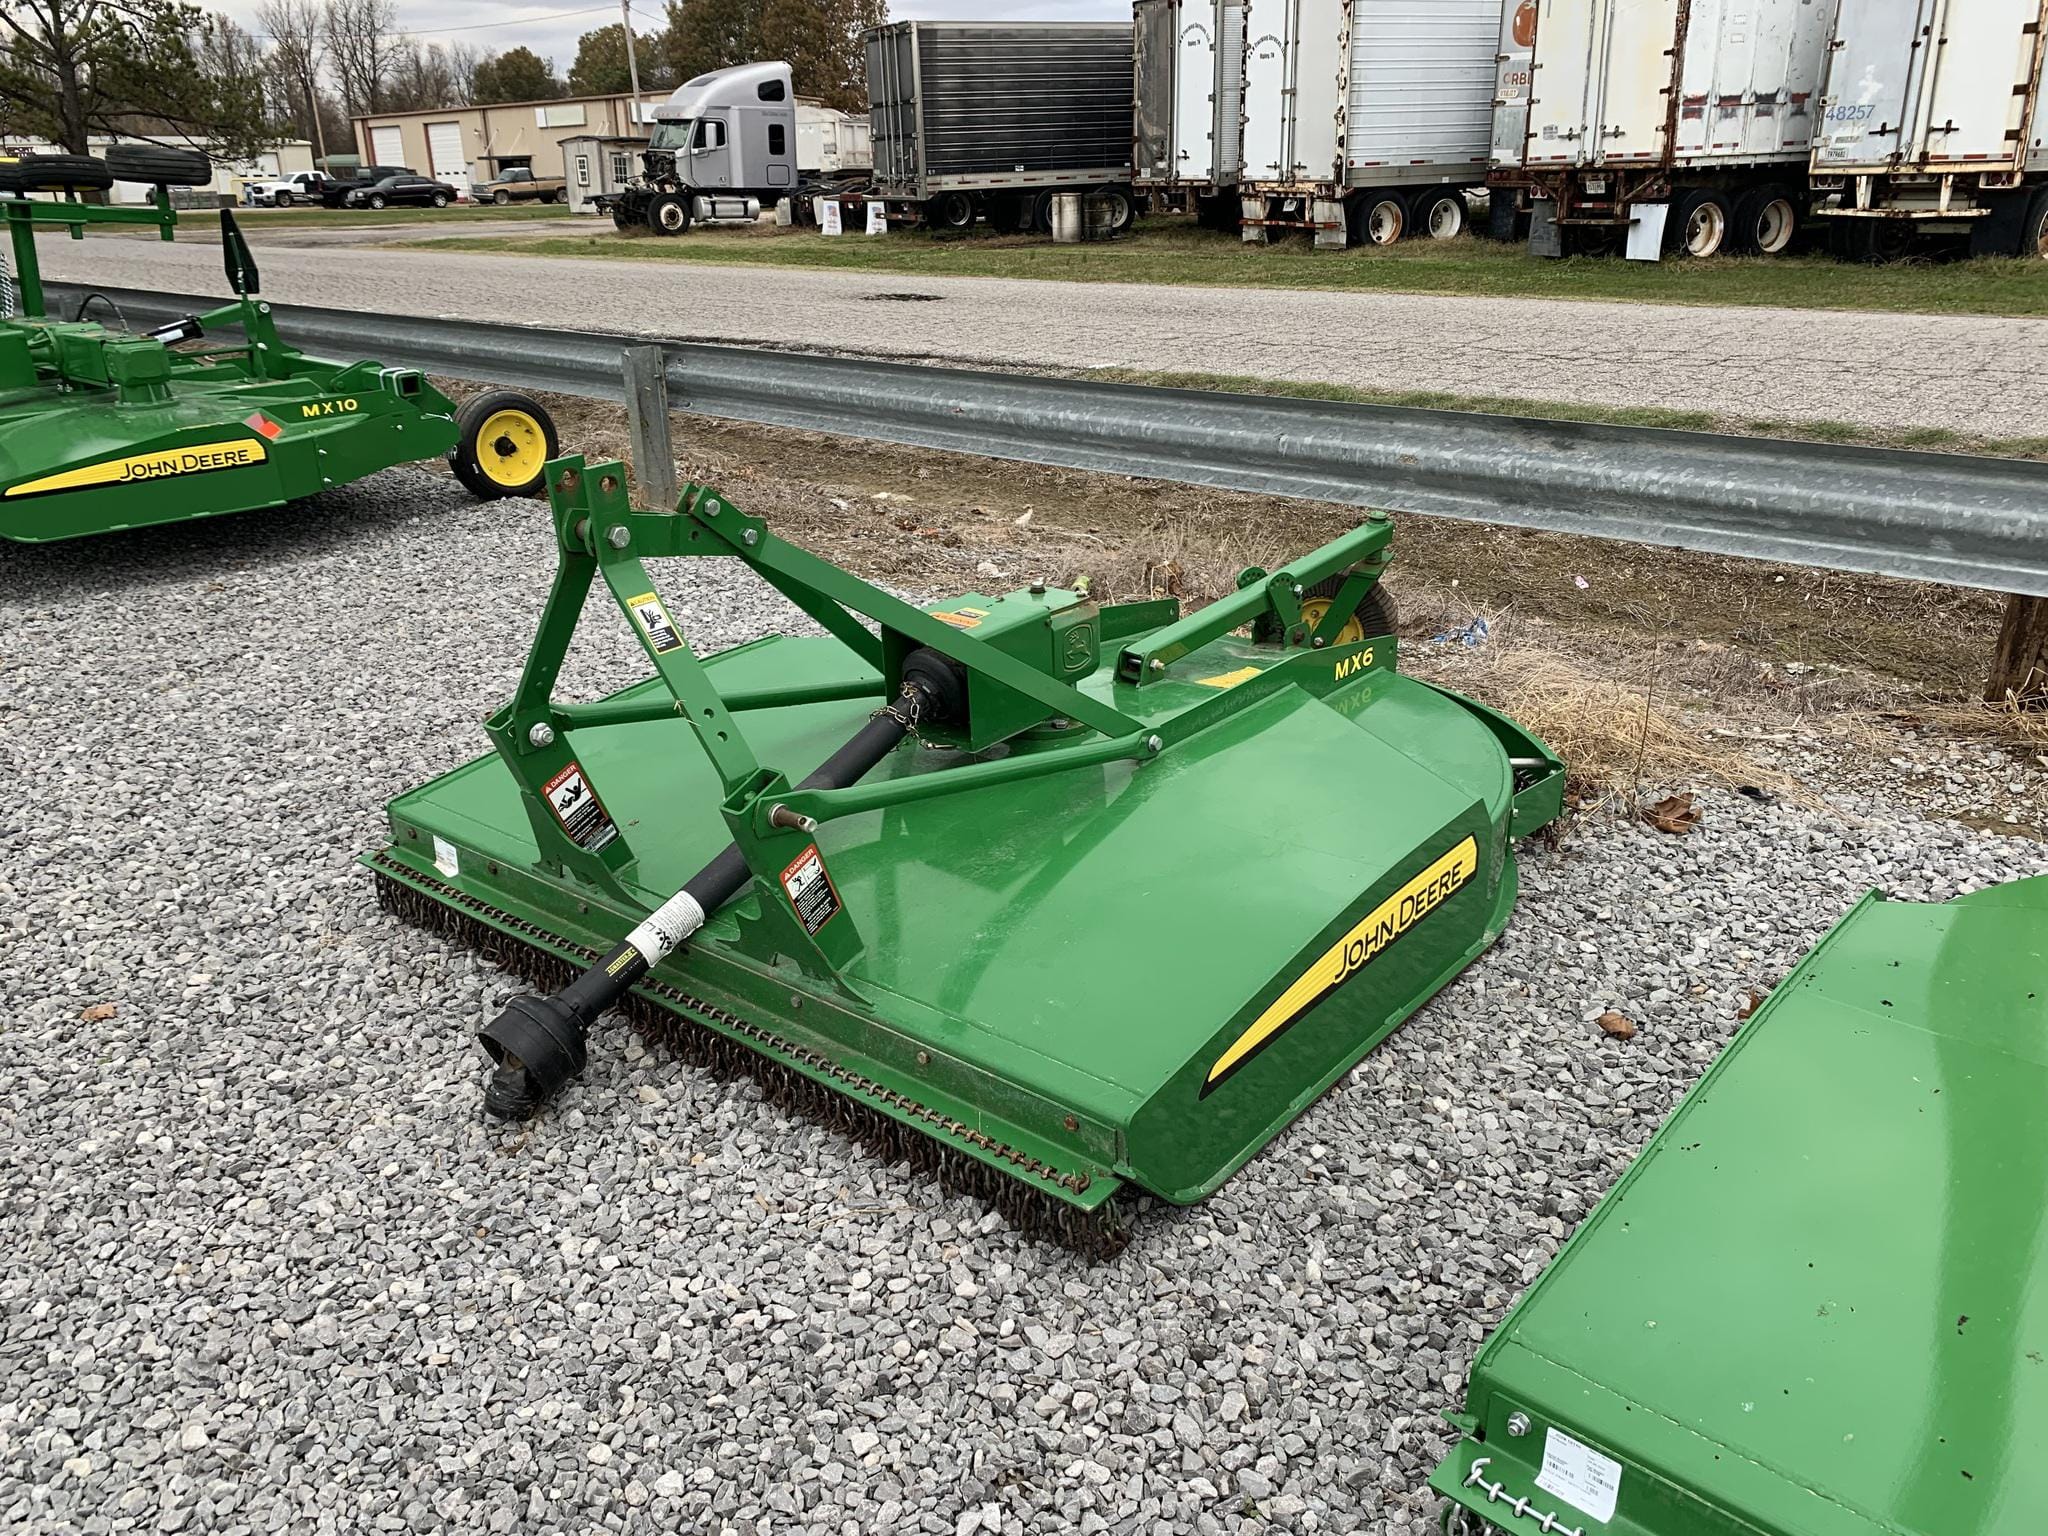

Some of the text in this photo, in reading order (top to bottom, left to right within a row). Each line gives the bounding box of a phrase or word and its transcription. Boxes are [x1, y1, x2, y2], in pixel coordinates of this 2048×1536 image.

[1826, 104, 1876, 121] 48257
[302, 398, 358, 418] MX10
[120, 449, 250, 480] JOHN DEERE
[1335, 646, 1374, 681] MX6
[550, 764, 577, 788] DANGER
[788, 848, 814, 874] DANGER
[1335, 861, 1464, 982] JOHN DEERE
